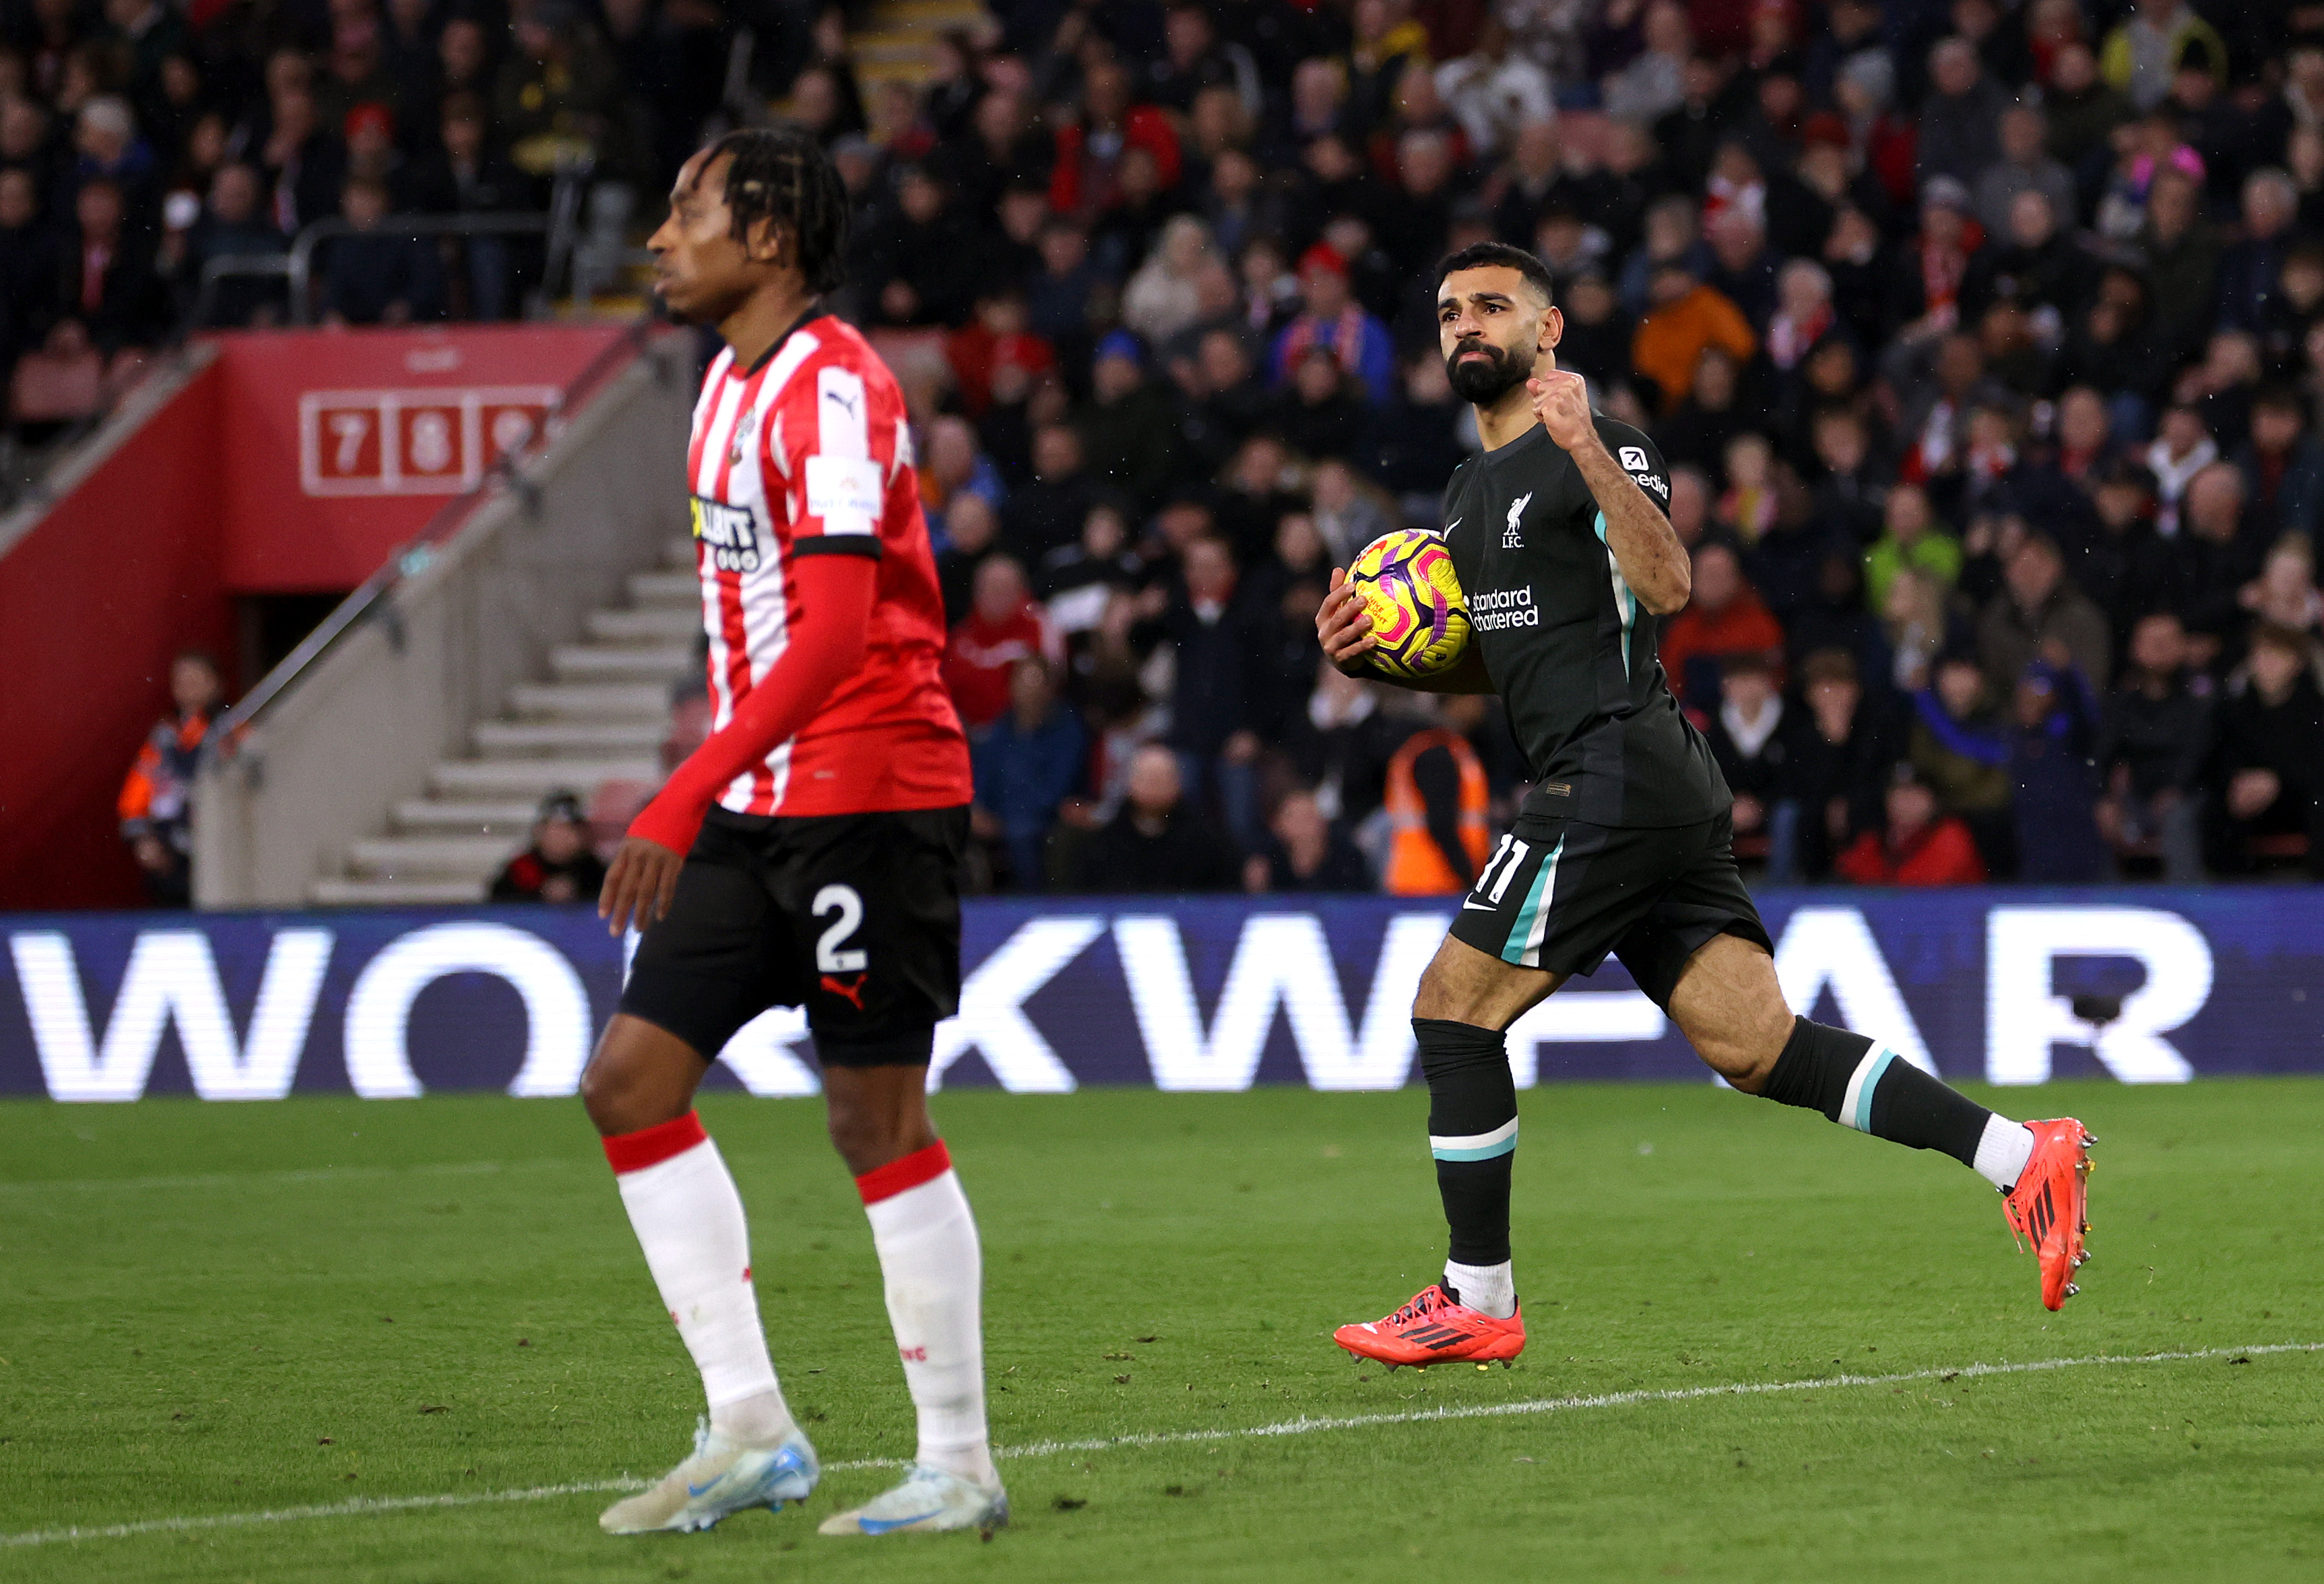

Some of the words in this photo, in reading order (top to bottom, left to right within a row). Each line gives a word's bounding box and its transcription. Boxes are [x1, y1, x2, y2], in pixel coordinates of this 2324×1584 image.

[329, 413, 369, 473] 7
[410, 409, 451, 471] 8
[1368, 595, 1384, 614] NIKE
[1473, 584, 1531, 612] standard
[1474, 605, 1539, 632] chartered
[1475, 833, 1530, 904] 11
[812, 884, 868, 972] 2
